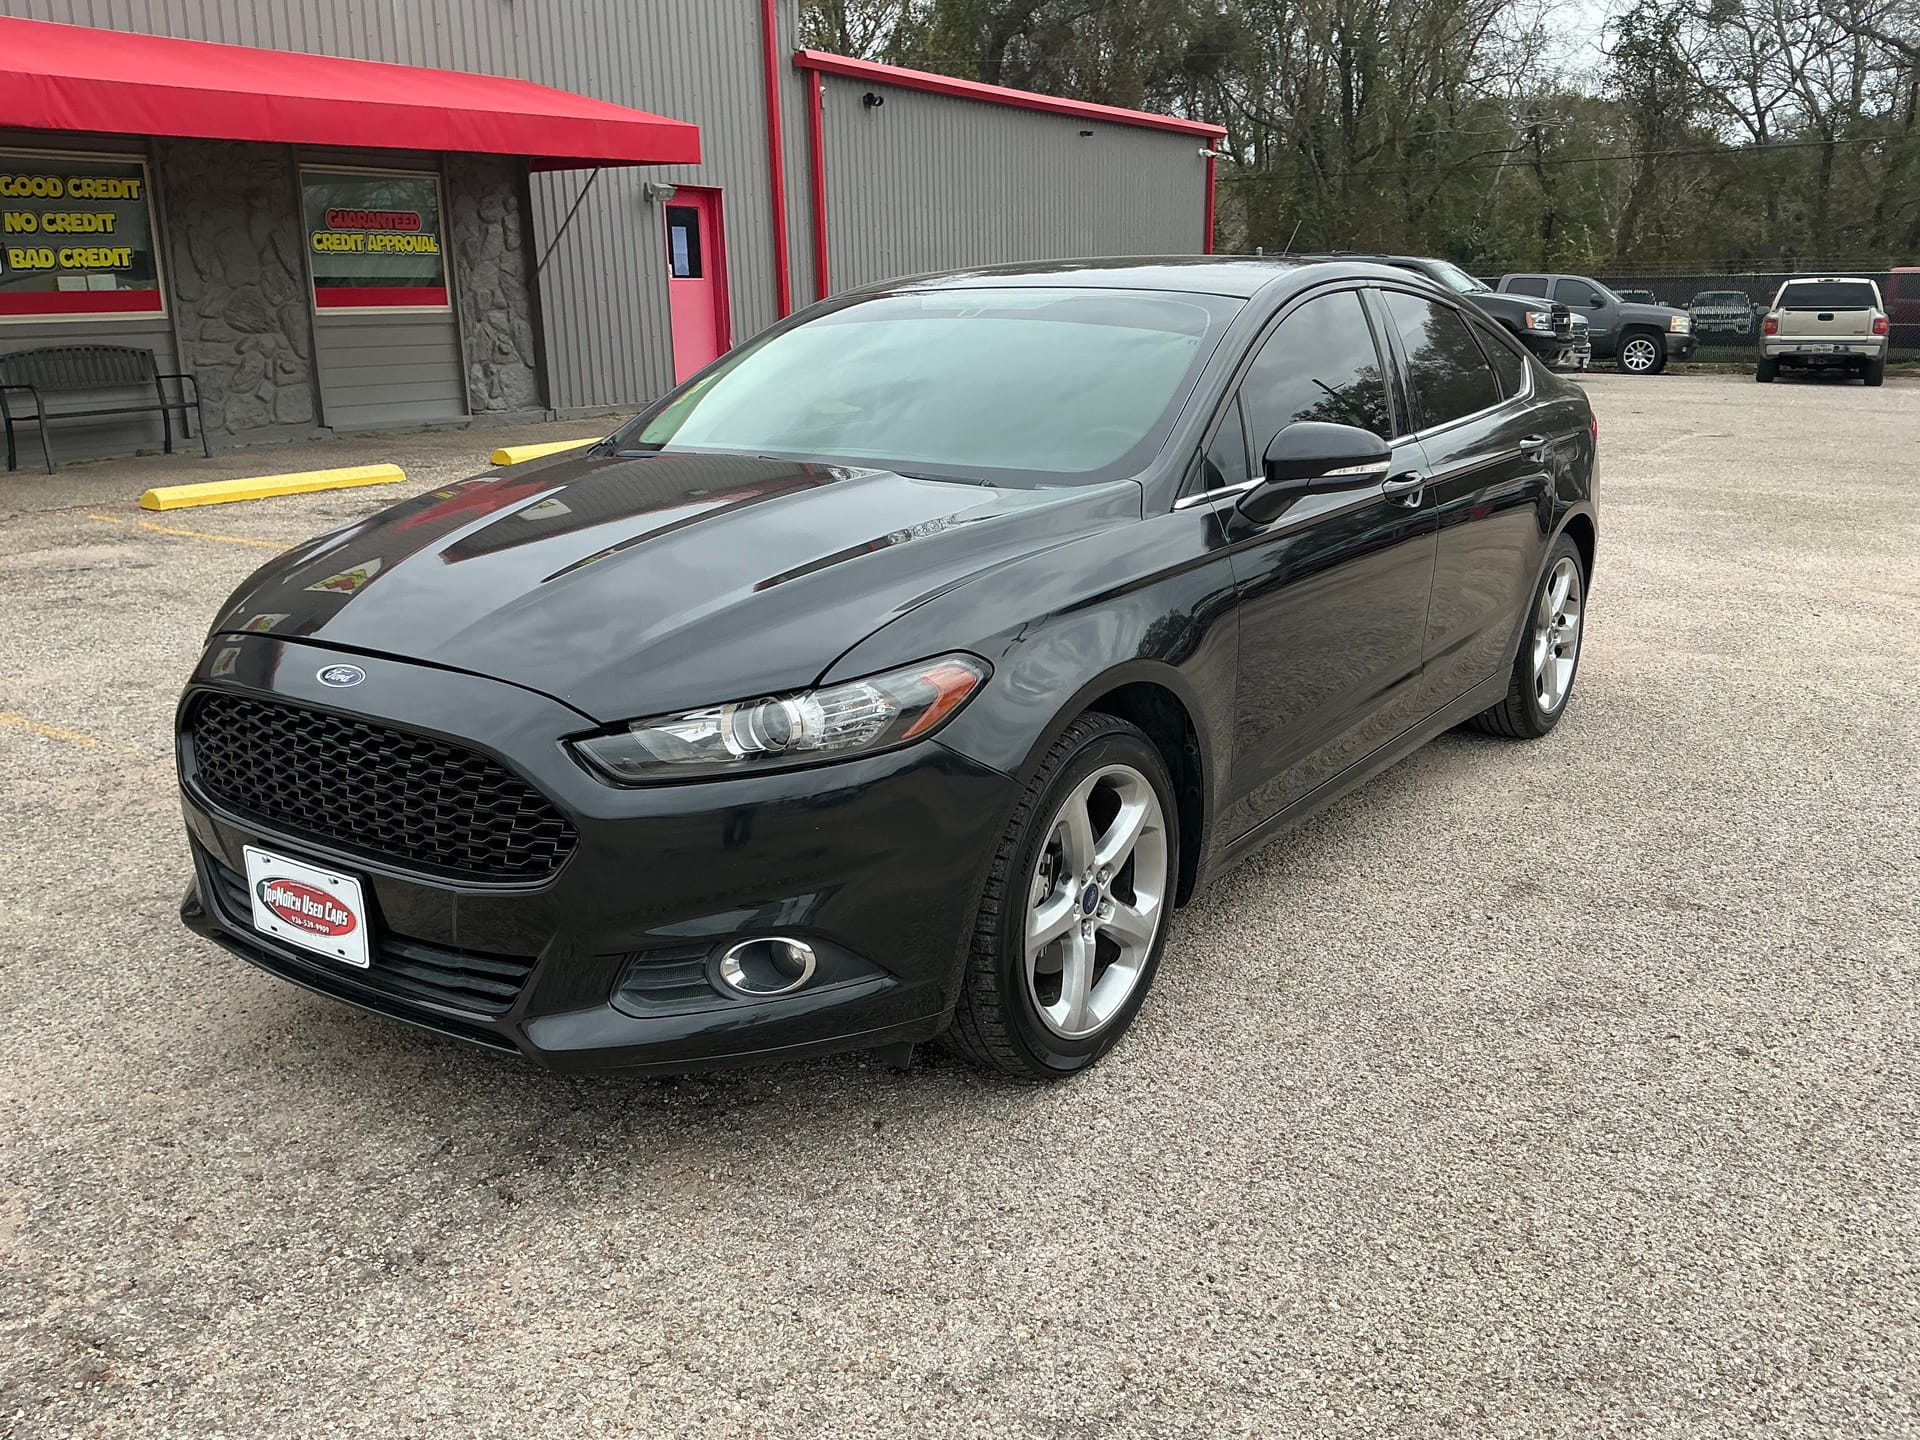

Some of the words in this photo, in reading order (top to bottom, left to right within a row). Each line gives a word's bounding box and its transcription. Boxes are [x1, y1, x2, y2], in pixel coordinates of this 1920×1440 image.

[0, 176, 63, 198] GOOD
[67, 178, 141, 200] CREDIT
[4, 212, 38, 233] NO
[41, 213, 116, 233] CREDIT
[327, 209, 420, 231] GUARANTEED
[312, 233, 364, 252] CREDIT
[367, 234, 438, 253] APPROVAL
[8, 248, 56, 269] BAD
[58, 248, 132, 269] CREDIT
[325, 668, 355, 682] Ford
